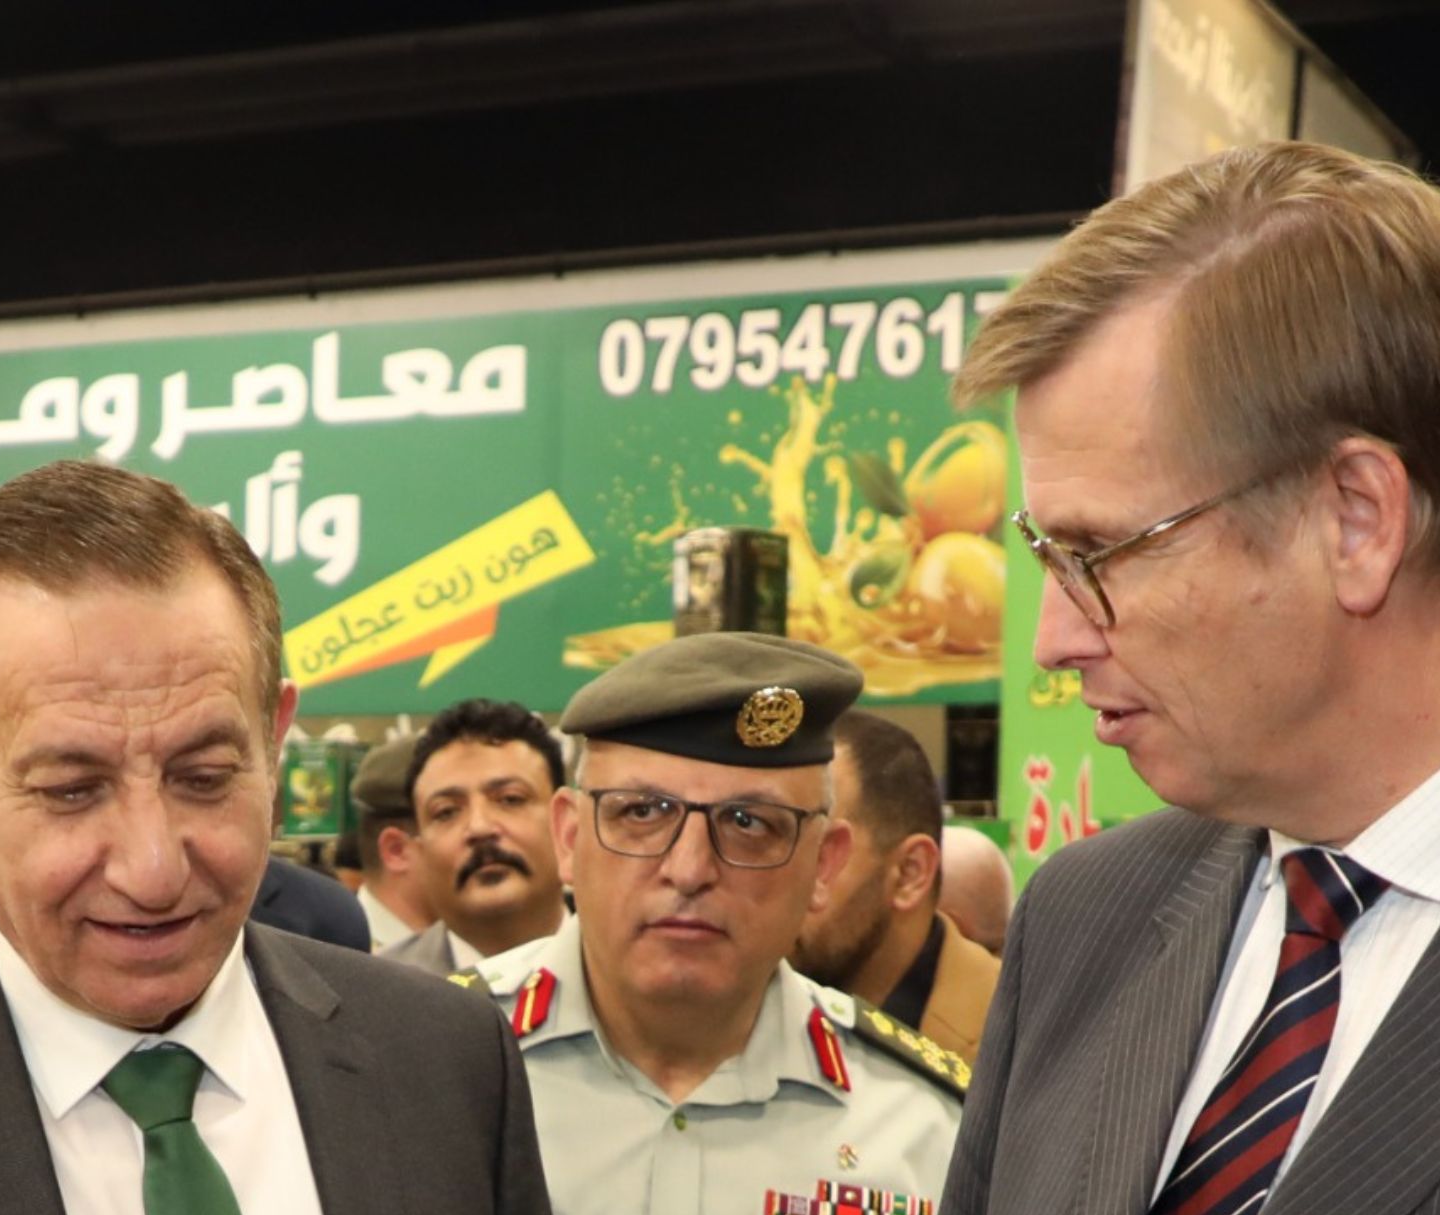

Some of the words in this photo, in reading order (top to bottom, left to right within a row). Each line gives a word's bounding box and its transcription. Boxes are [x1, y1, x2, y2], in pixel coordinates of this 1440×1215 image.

[599, 292, 1006, 397] 07954761
[152, 332, 528, 460] معاصر
[412, 564, 475, 612] زيت
[484, 525, 561, 584] هون
[299, 602, 406, 675] عجلون
